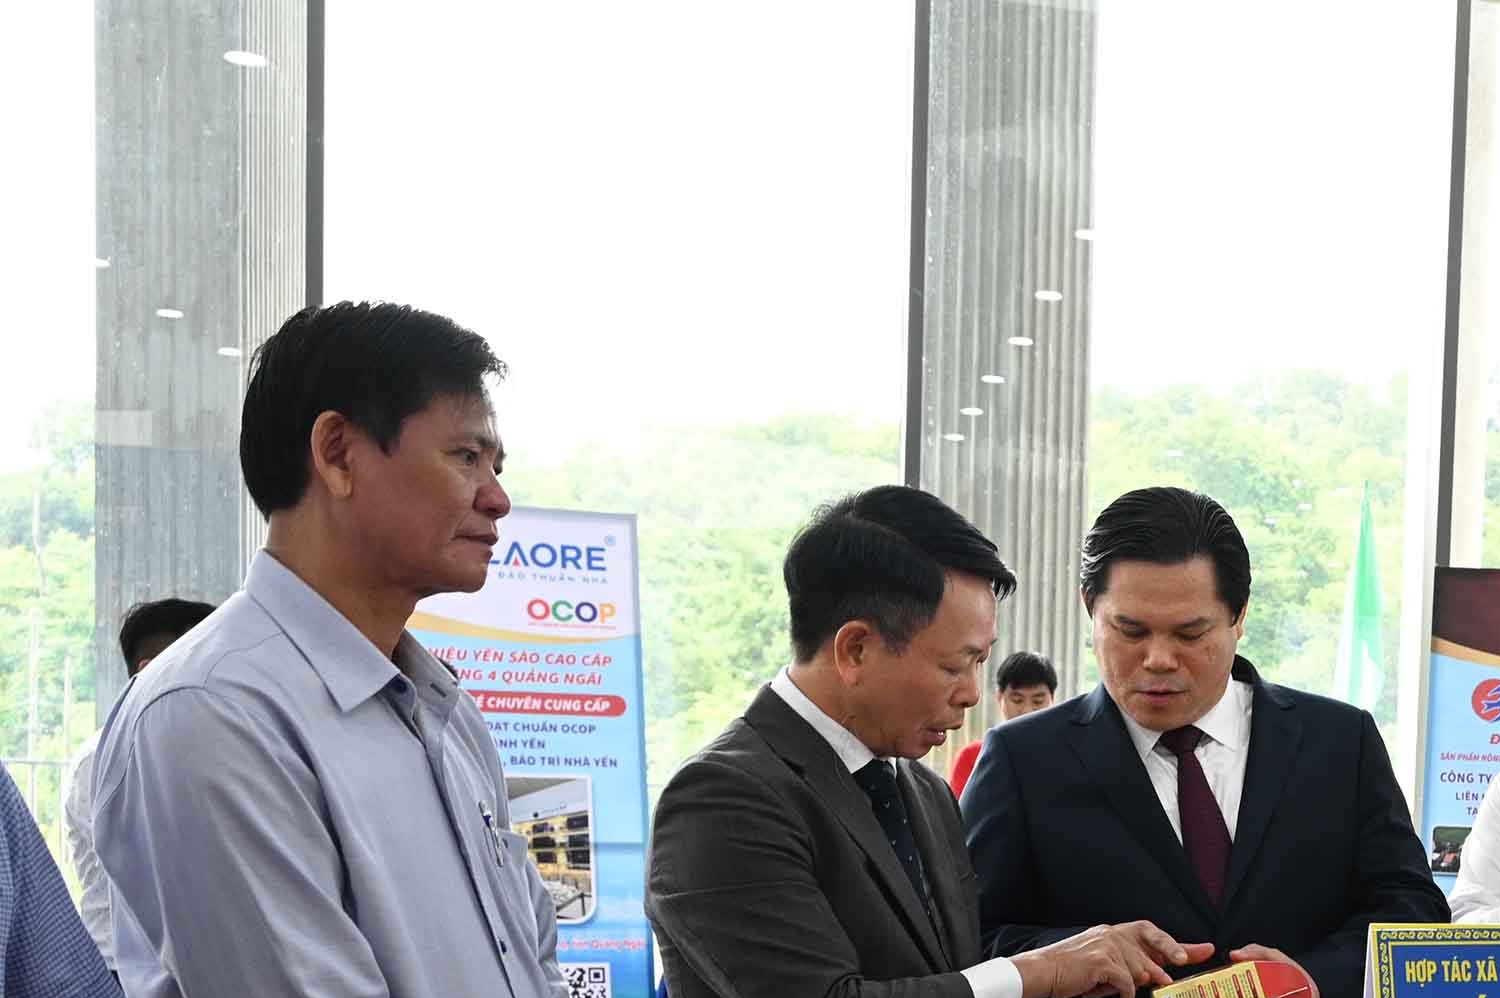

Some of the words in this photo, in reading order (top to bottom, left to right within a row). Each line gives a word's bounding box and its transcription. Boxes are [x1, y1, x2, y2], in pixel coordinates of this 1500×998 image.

[527, 599, 616, 624] OCOP
[546, 653, 576, 665] CAO
[489, 671, 496, 680] 4
[487, 696, 541, 710] CHUYÊN
[545, 699, 580, 711] CUNG
[561, 724, 596, 734] OCOP
[1440, 771, 1474, 783] CÔNG
[1479, 774, 1492, 784] TY
[1405, 958, 1436, 989] HỢP
[1442, 956, 1471, 983] TÁC
[1476, 955, 1496, 982] XÃ
